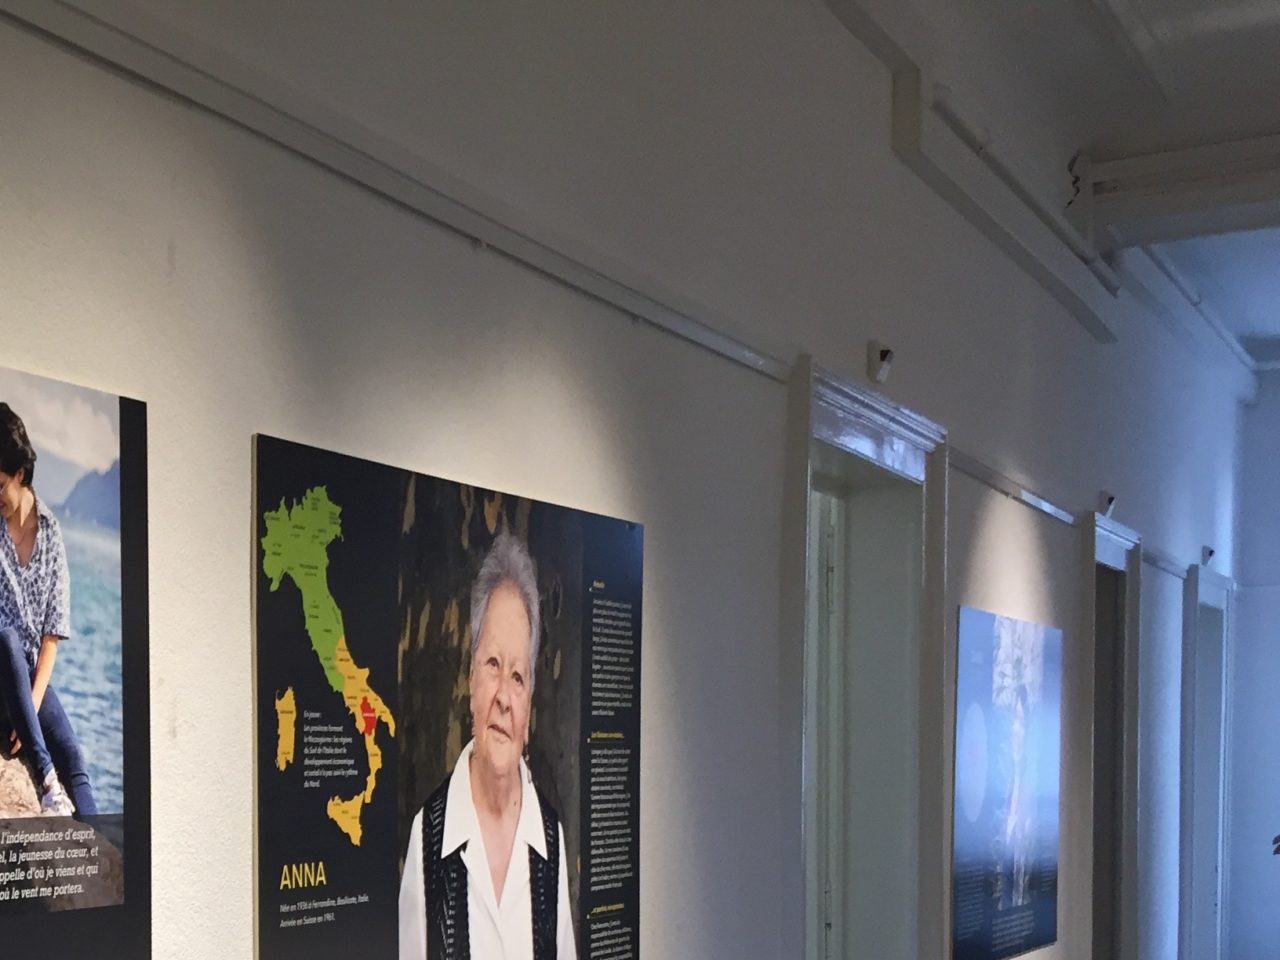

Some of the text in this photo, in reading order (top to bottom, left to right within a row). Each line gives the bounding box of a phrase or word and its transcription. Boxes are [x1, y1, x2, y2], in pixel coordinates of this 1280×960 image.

[0, 828, 64, 846] l'indépendance
[63, 827, 96, 843] d'esprit,
[7, 849, 17, 863] la
[16, 848, 53, 865] jeunesse
[53, 846, 65, 859] du
[65, 847, 89, 858] cœur,
[90, 845, 99, 857] et
[279, 860, 327, 890] ANNA
